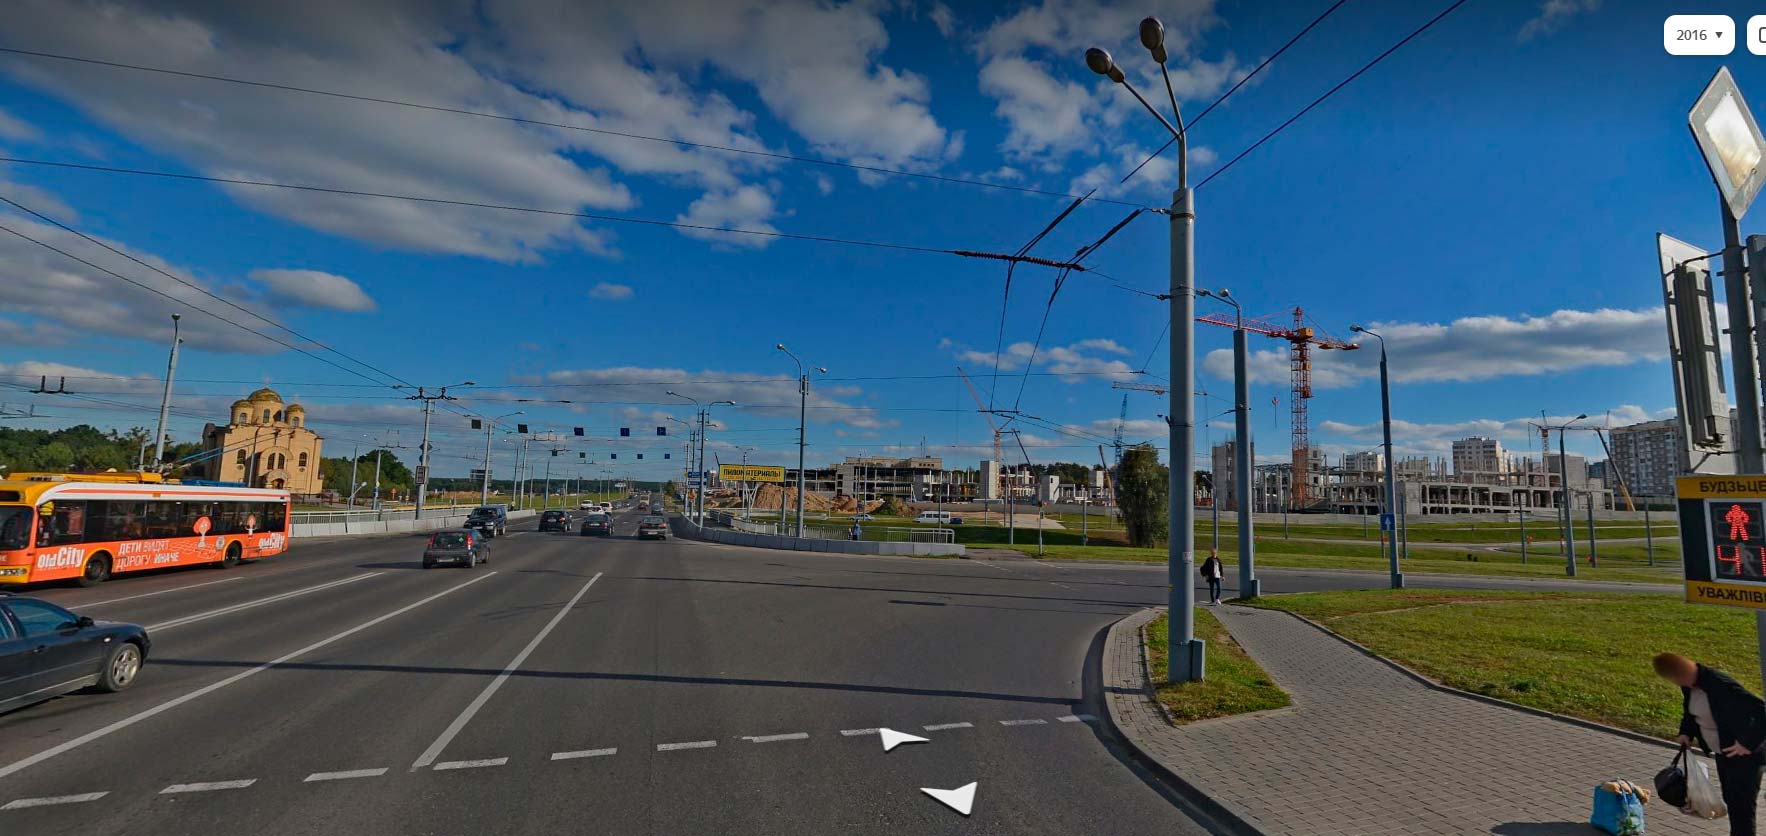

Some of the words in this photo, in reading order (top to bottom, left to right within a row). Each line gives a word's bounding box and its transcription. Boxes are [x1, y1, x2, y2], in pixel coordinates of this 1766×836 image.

[1699, 480, 1766, 494] БУДЗЬЦЕ
[118, 542, 142, 556] ДЕТИ
[116, 554, 151, 569] ДОРОГУ
[154, 552, 180, 564] ИНАЧЕ
[1697, 586, 1766, 603] УВАЖЛІВ
